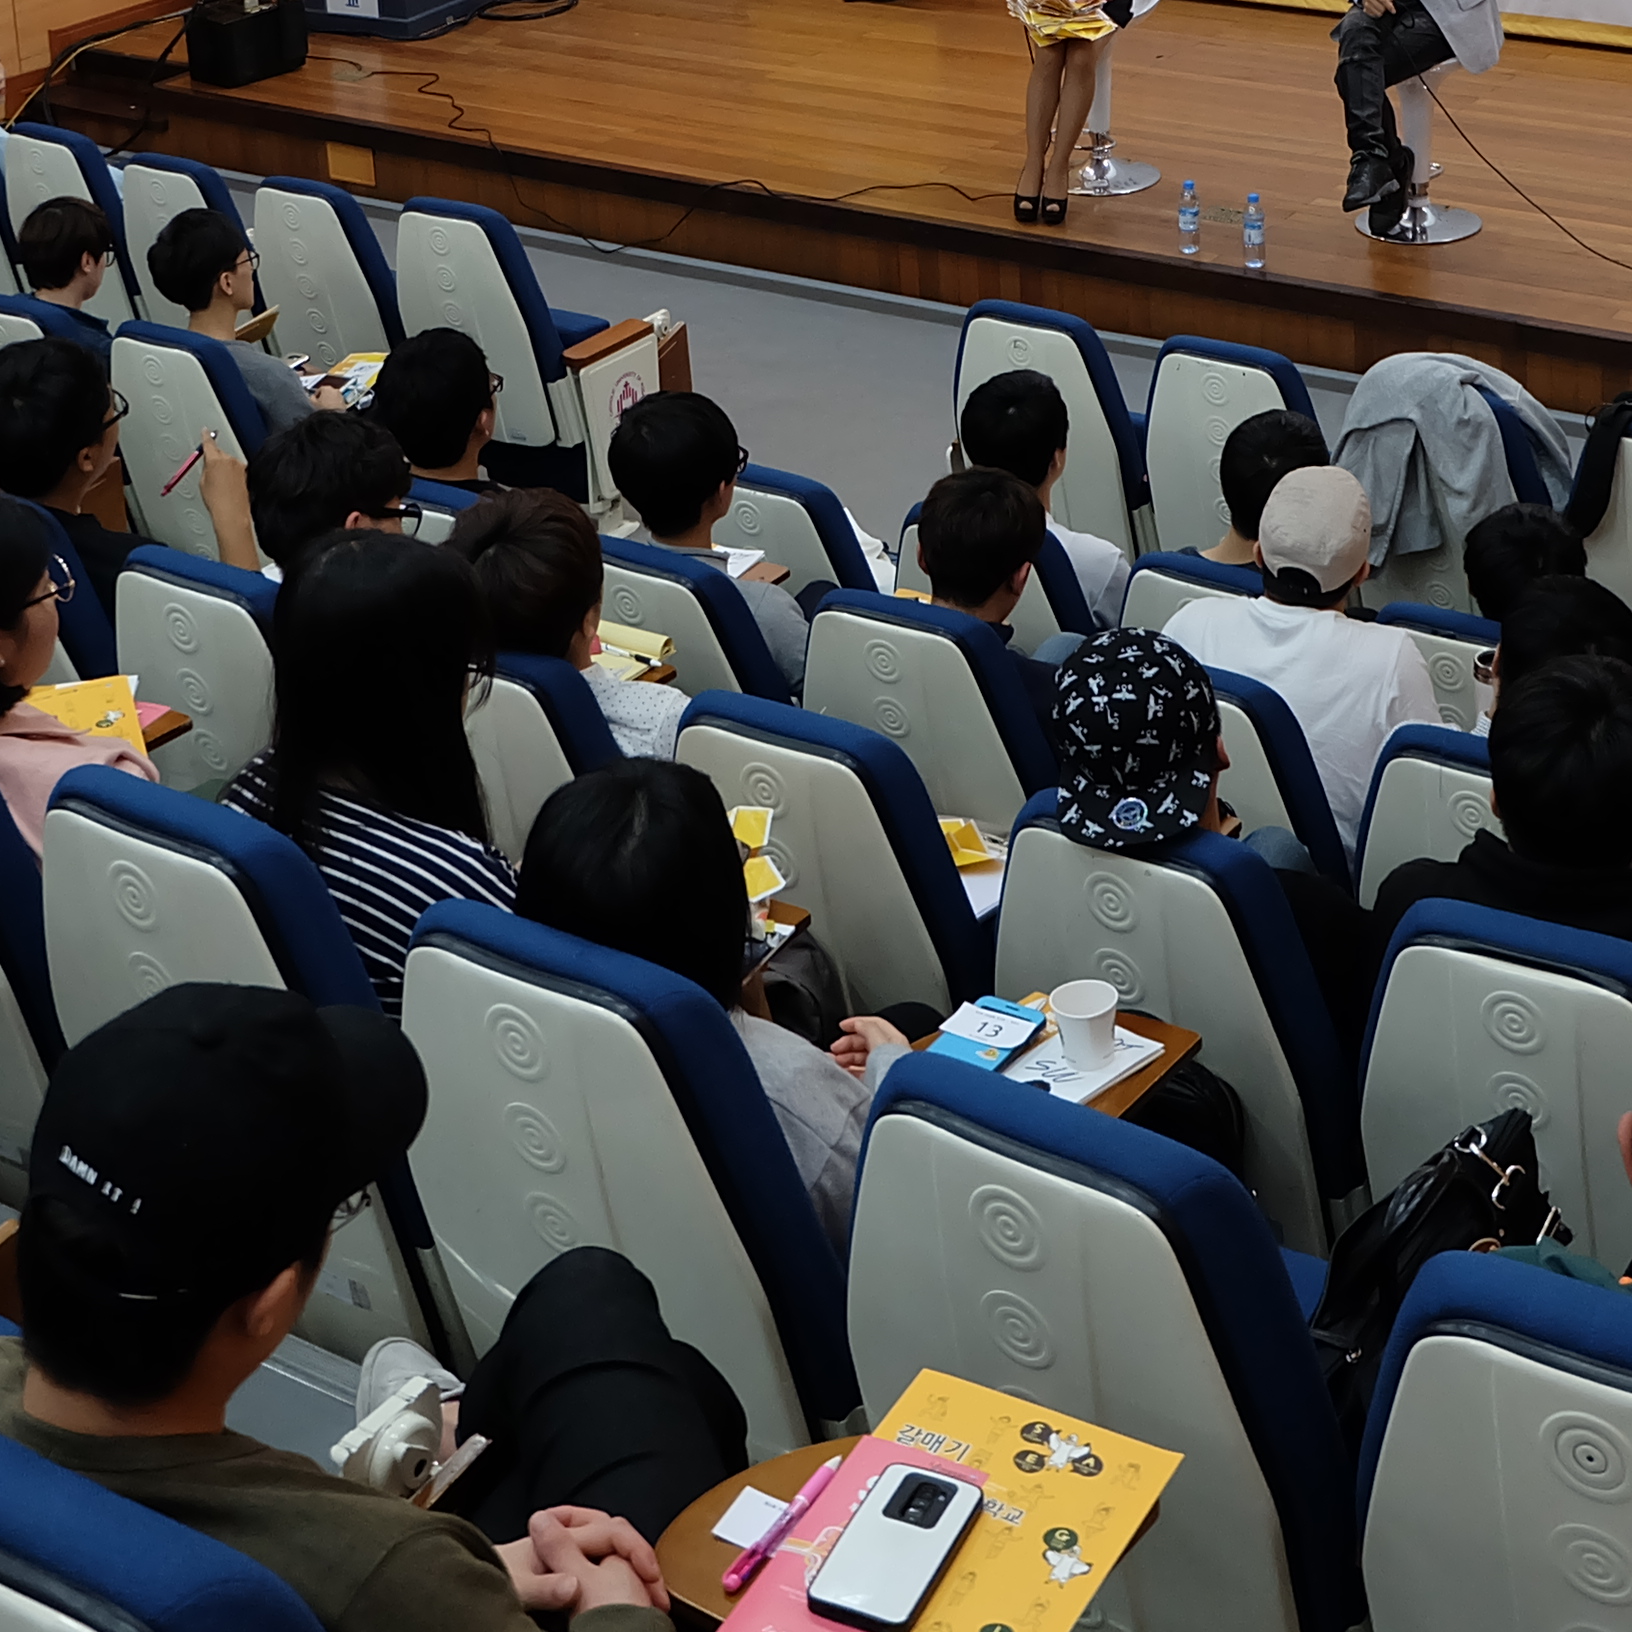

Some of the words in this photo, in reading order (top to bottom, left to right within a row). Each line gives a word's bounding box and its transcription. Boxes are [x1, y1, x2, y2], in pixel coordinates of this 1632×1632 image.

[976, 1020, 1003, 1038] 13
[58, 1144, 98, 1186] DAMN
[895, 1423, 973, 1463] 갈매기
[1025, 1452, 1039, 1464] E
